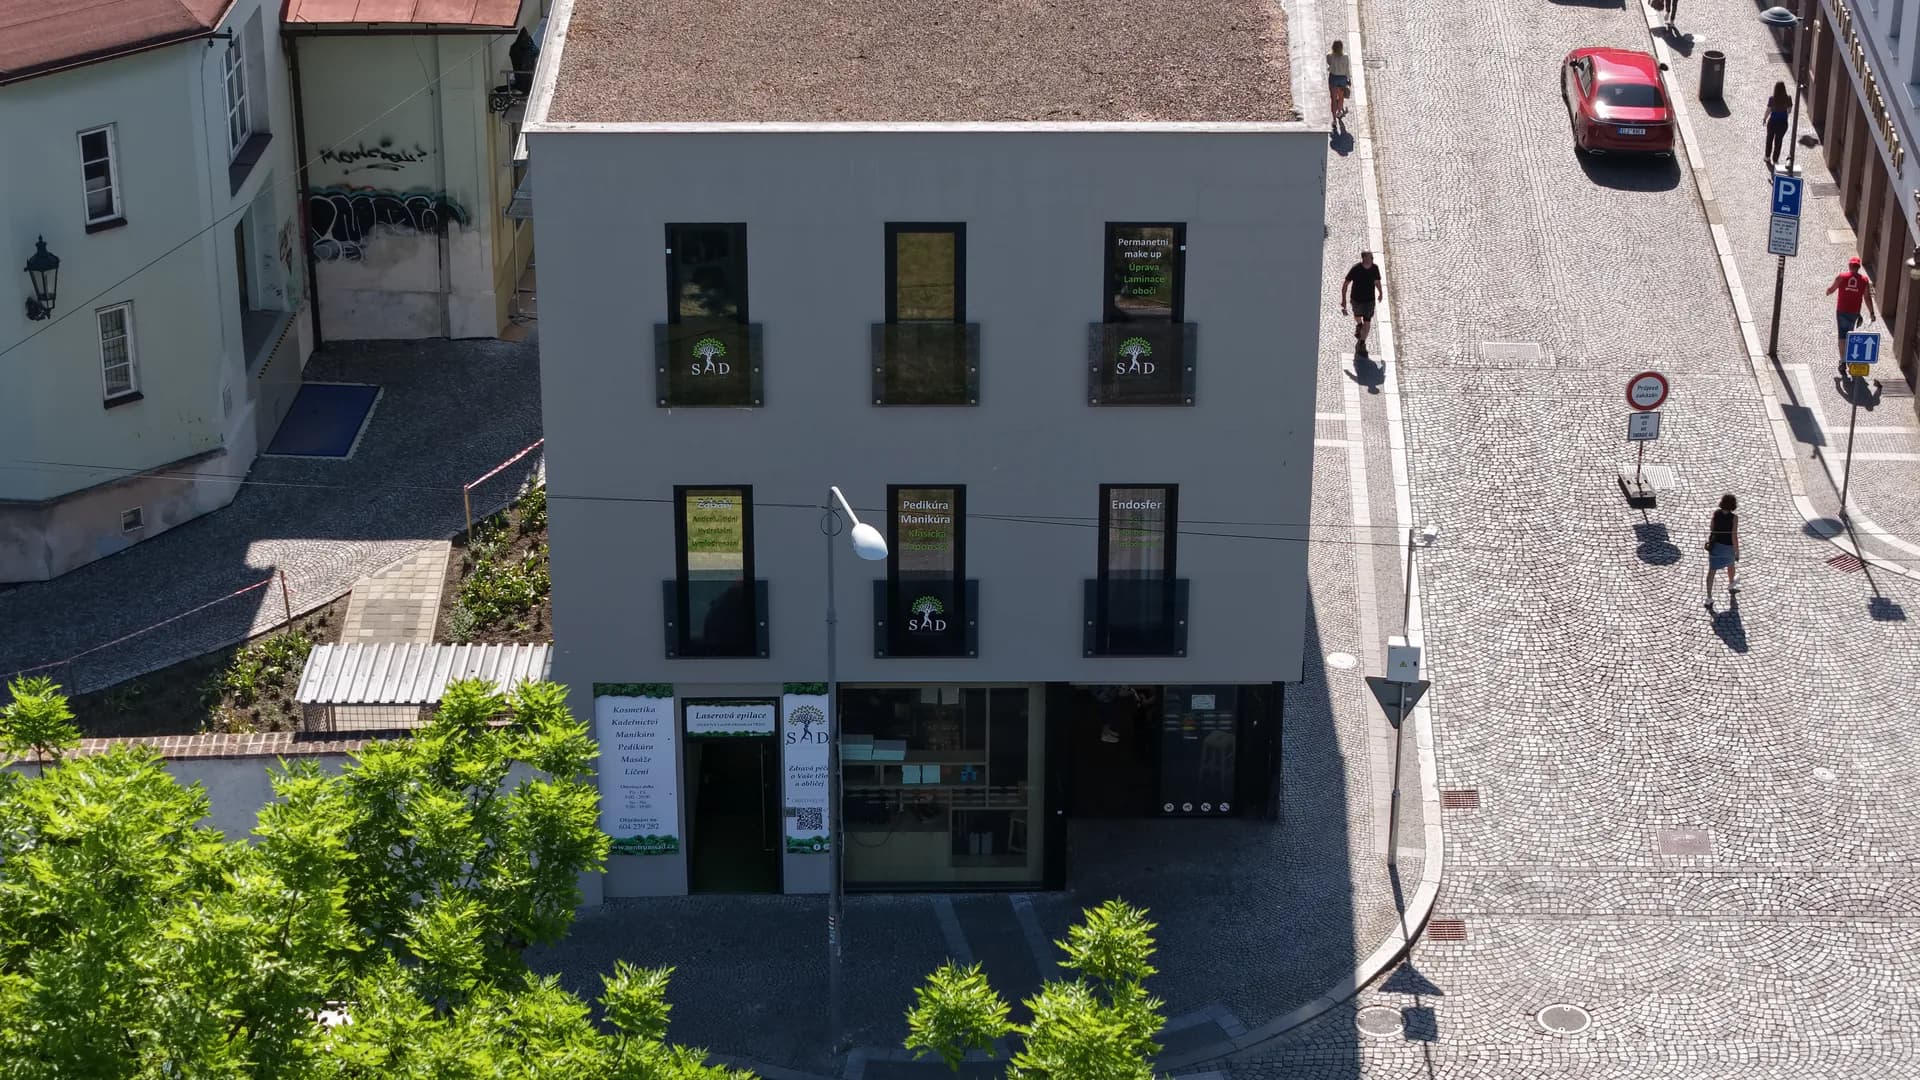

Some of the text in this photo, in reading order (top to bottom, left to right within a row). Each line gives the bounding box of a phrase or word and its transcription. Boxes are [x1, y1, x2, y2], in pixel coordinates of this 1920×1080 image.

[1778, 181, 1796, 203] P
[1118, 238, 1169, 246] Permanetní
[1124, 250, 1162, 260] make up
[1128, 262, 1159, 272] Úprava
[1124, 276, 1165, 284] Laminace
[1132, 286, 1156, 295] obočí
[903, 500, 949, 510] Pedikúra
[1112, 500, 1162, 510] Endosfer
[901, 514, 951, 524] Manikúra
[695, 711, 767, 721] Laserová epilace
[618, 743, 654, 751] Pedikúra
[620, 755, 652, 763] Masáže
